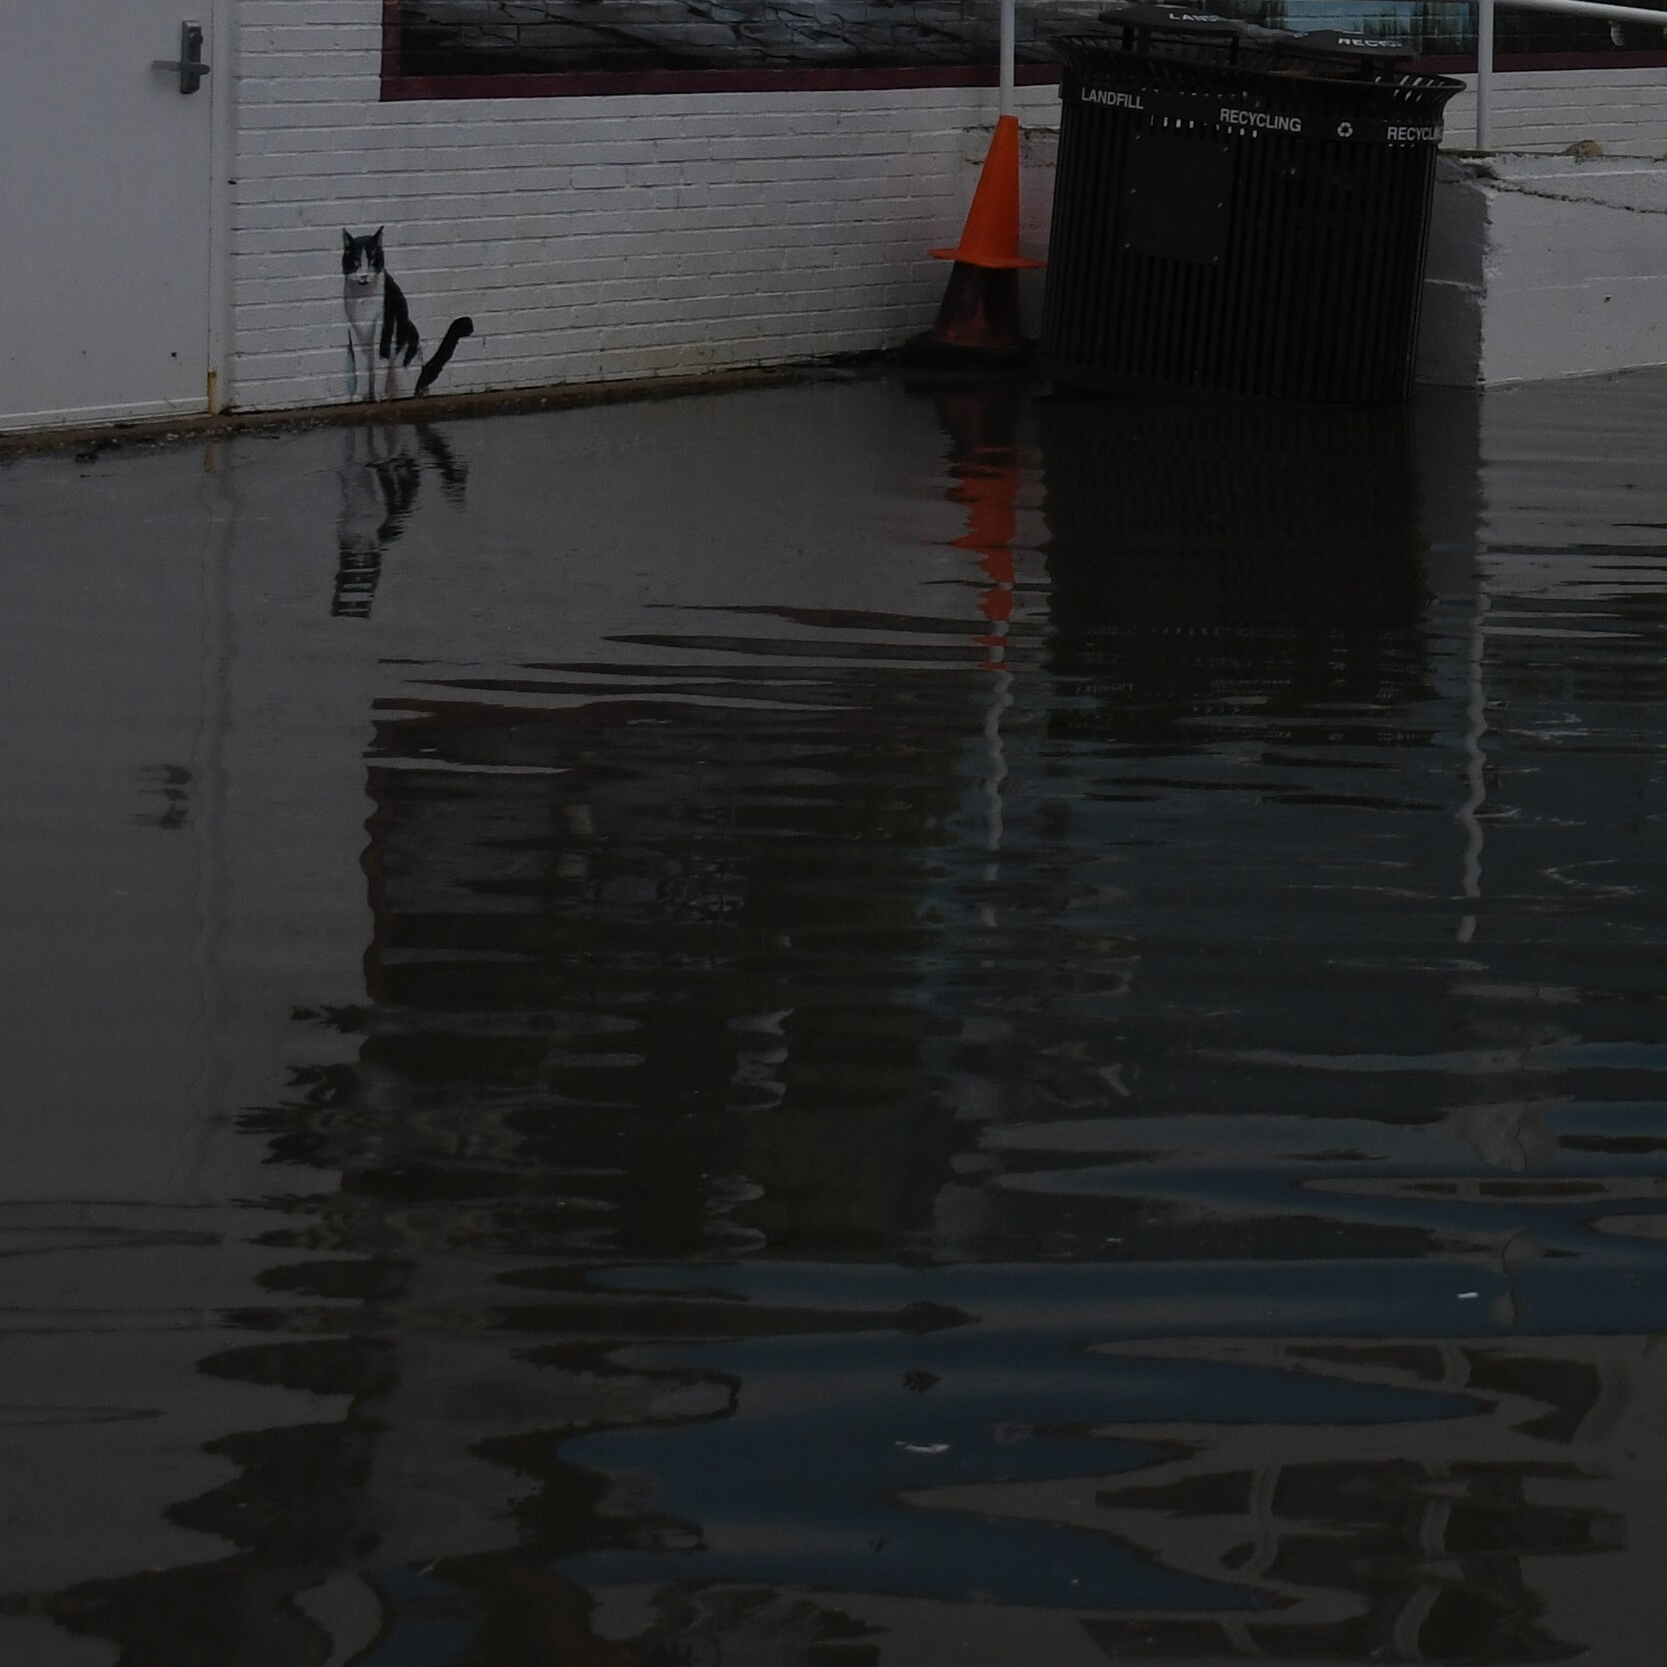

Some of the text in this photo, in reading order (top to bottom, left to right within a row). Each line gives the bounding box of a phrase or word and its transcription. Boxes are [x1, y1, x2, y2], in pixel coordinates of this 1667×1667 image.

[1081, 88, 1144, 110] LANDFILL
[1220, 108, 1302, 133] RECYCLING
[1387, 126, 1441, 141] RECYCL
